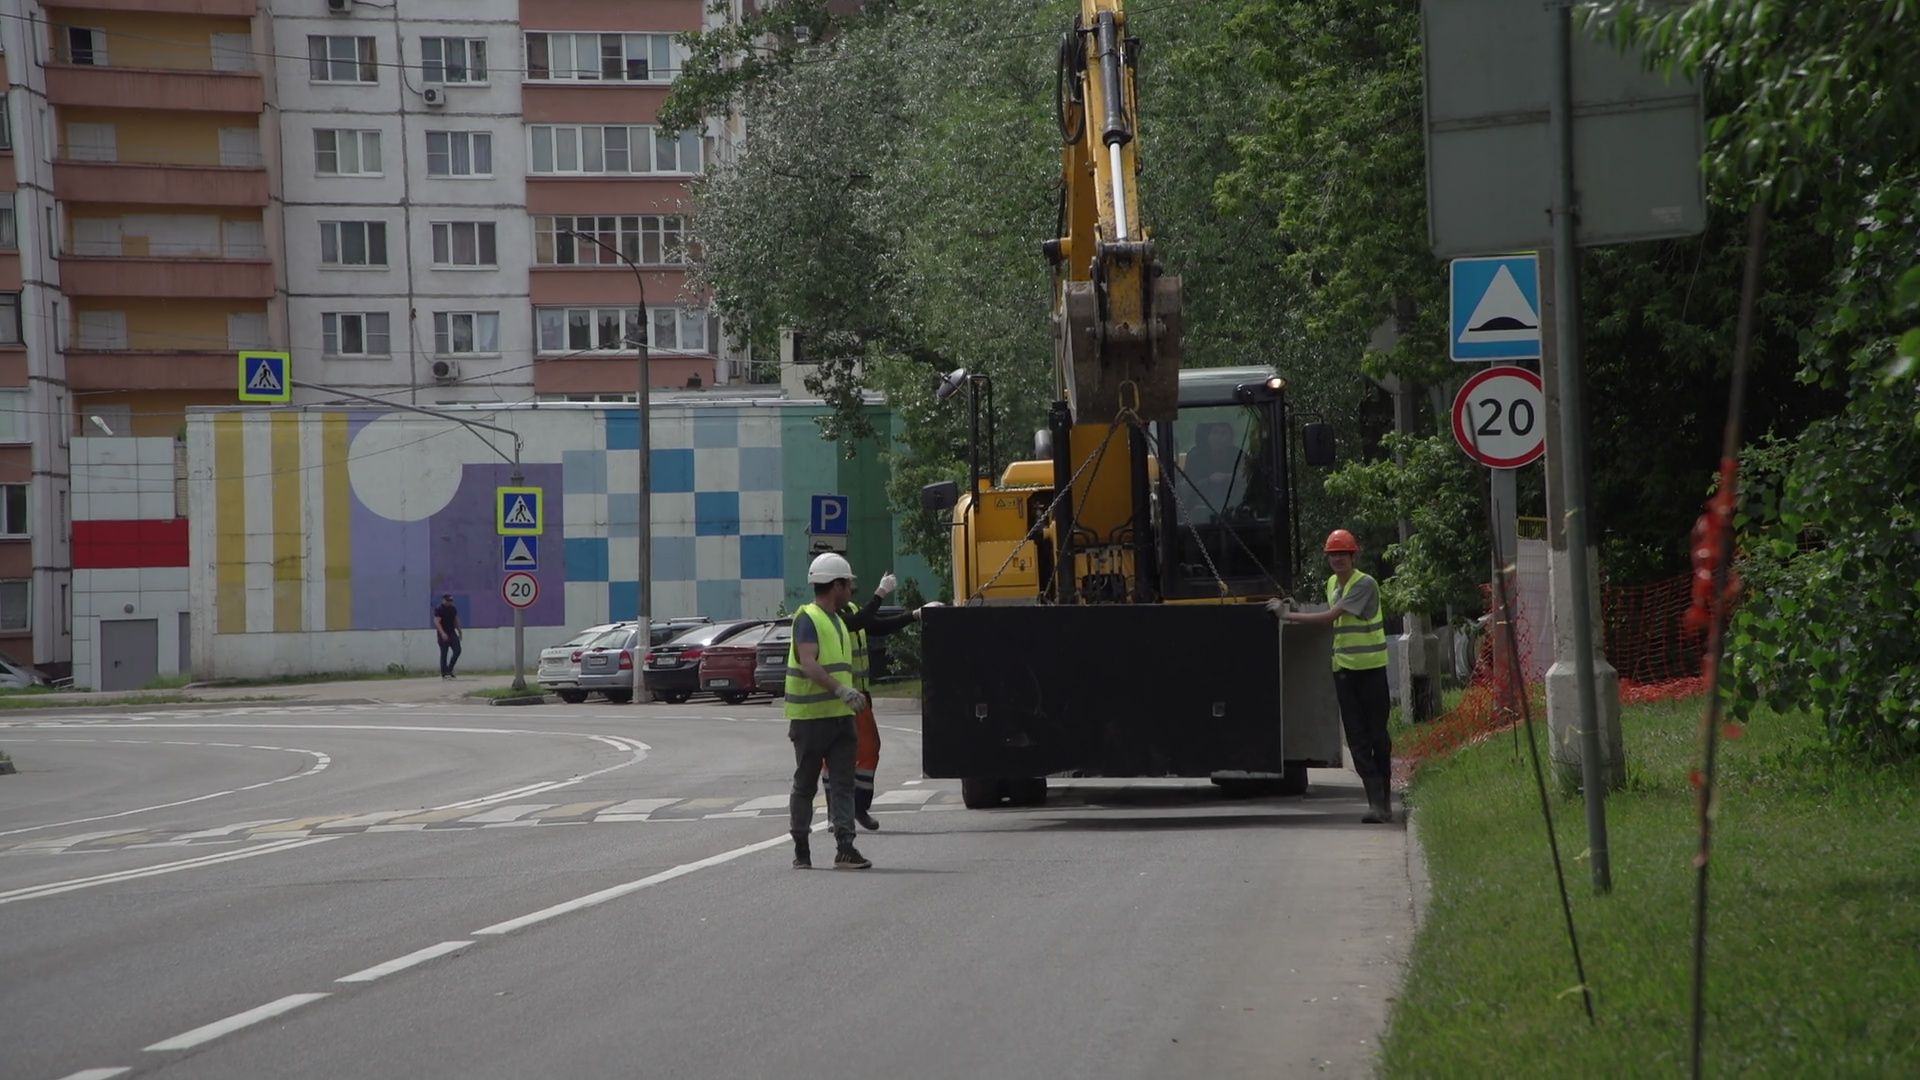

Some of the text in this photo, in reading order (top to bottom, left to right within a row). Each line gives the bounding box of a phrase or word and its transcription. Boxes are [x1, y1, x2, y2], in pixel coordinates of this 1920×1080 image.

[1477, 398, 1535, 436] 20
[821, 500, 842, 531] P
[511, 583, 531, 597] 20
